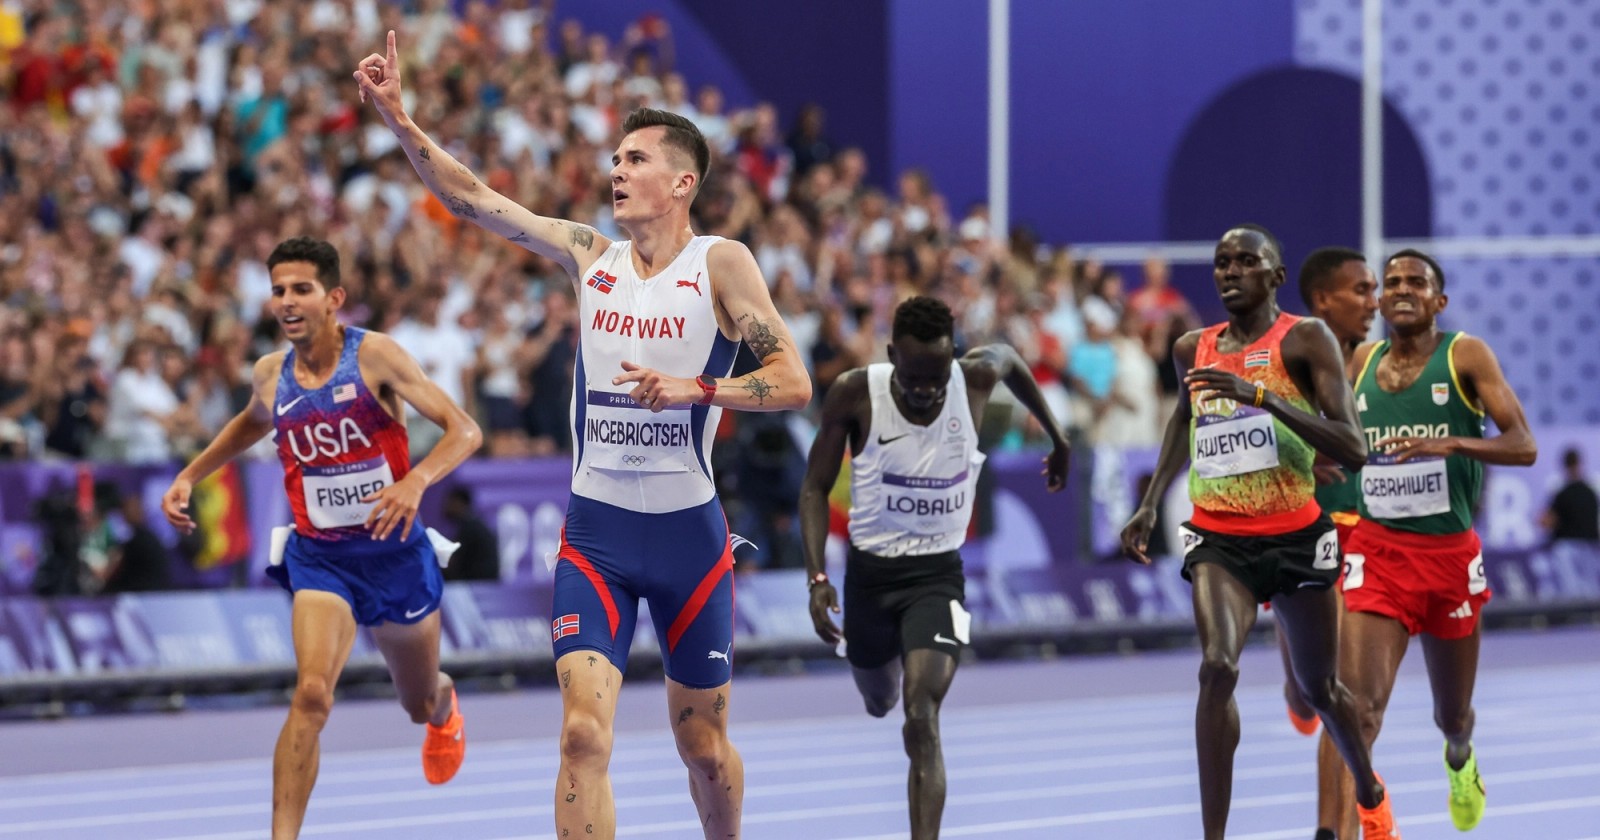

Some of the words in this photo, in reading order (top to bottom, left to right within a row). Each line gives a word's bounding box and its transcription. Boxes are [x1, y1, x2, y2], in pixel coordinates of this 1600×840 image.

[591, 308, 686, 339] NORWAY
[609, 396, 636, 405] PARIS
[287, 417, 372, 462] USA
[587, 418, 689, 447] INGEBRIGTSEN
[1196, 426, 1274, 460] KWEMOI
[316, 480, 385, 507] FISHER
[1364, 471, 1443, 497] GEBRHIWET
[887, 491, 965, 516] LOBALU
